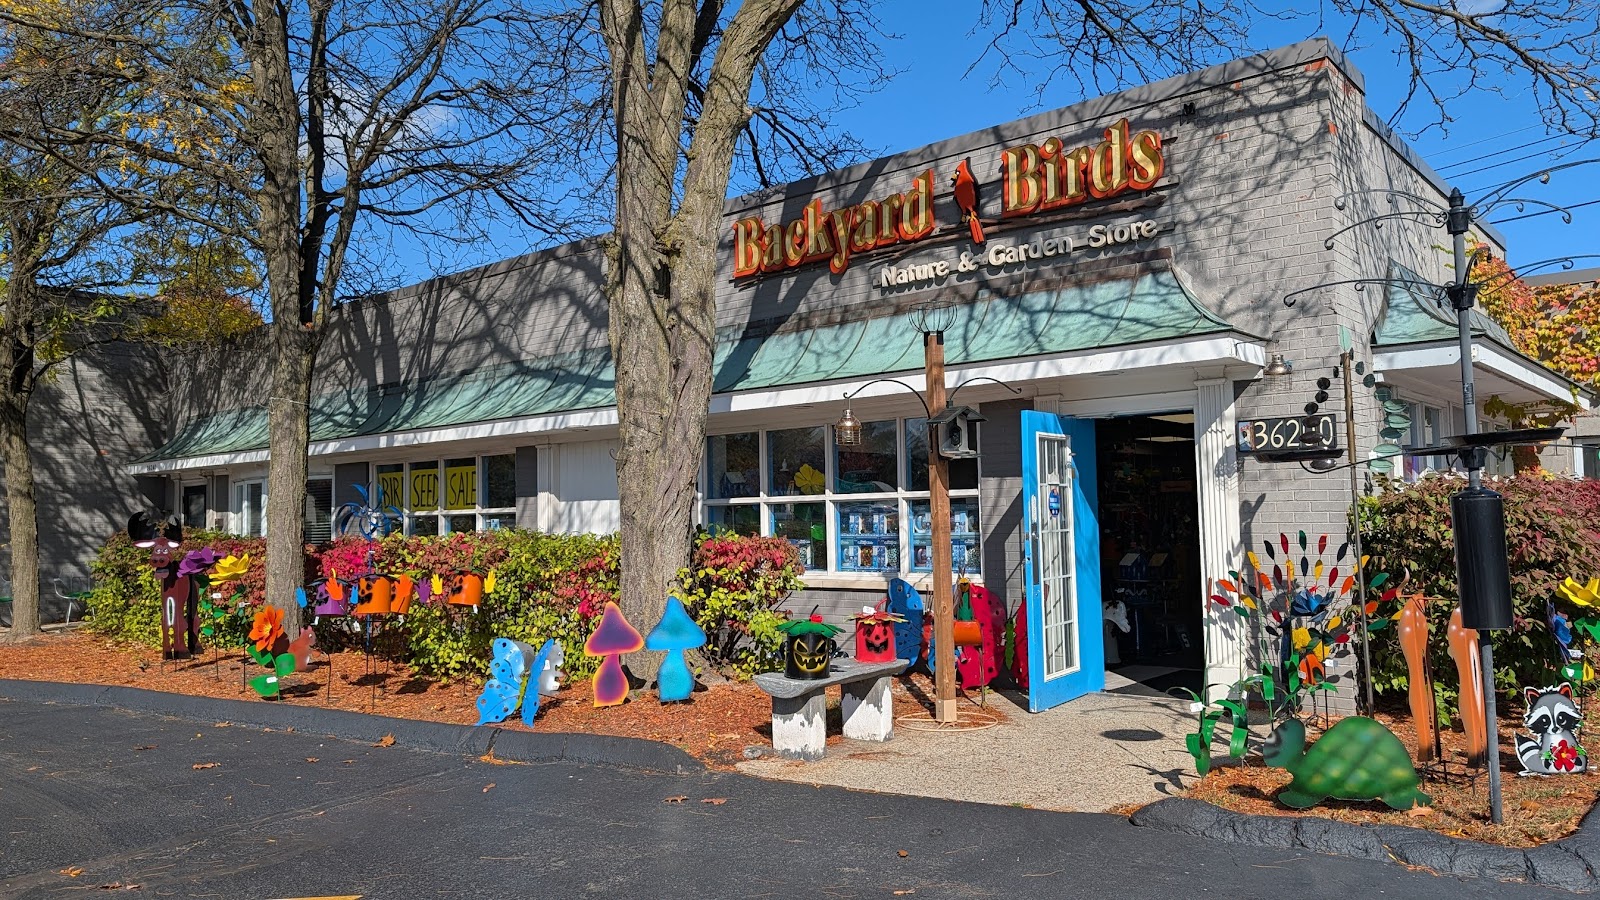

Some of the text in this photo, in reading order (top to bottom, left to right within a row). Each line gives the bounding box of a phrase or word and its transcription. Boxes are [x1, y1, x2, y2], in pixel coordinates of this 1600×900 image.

[733, 117, 1165, 278] Backyard Birds
[880, 219, 1158, 288] Nature & Garden Store
[412, 473, 439, 508] SEED
[449, 470, 477, 506] SALE
